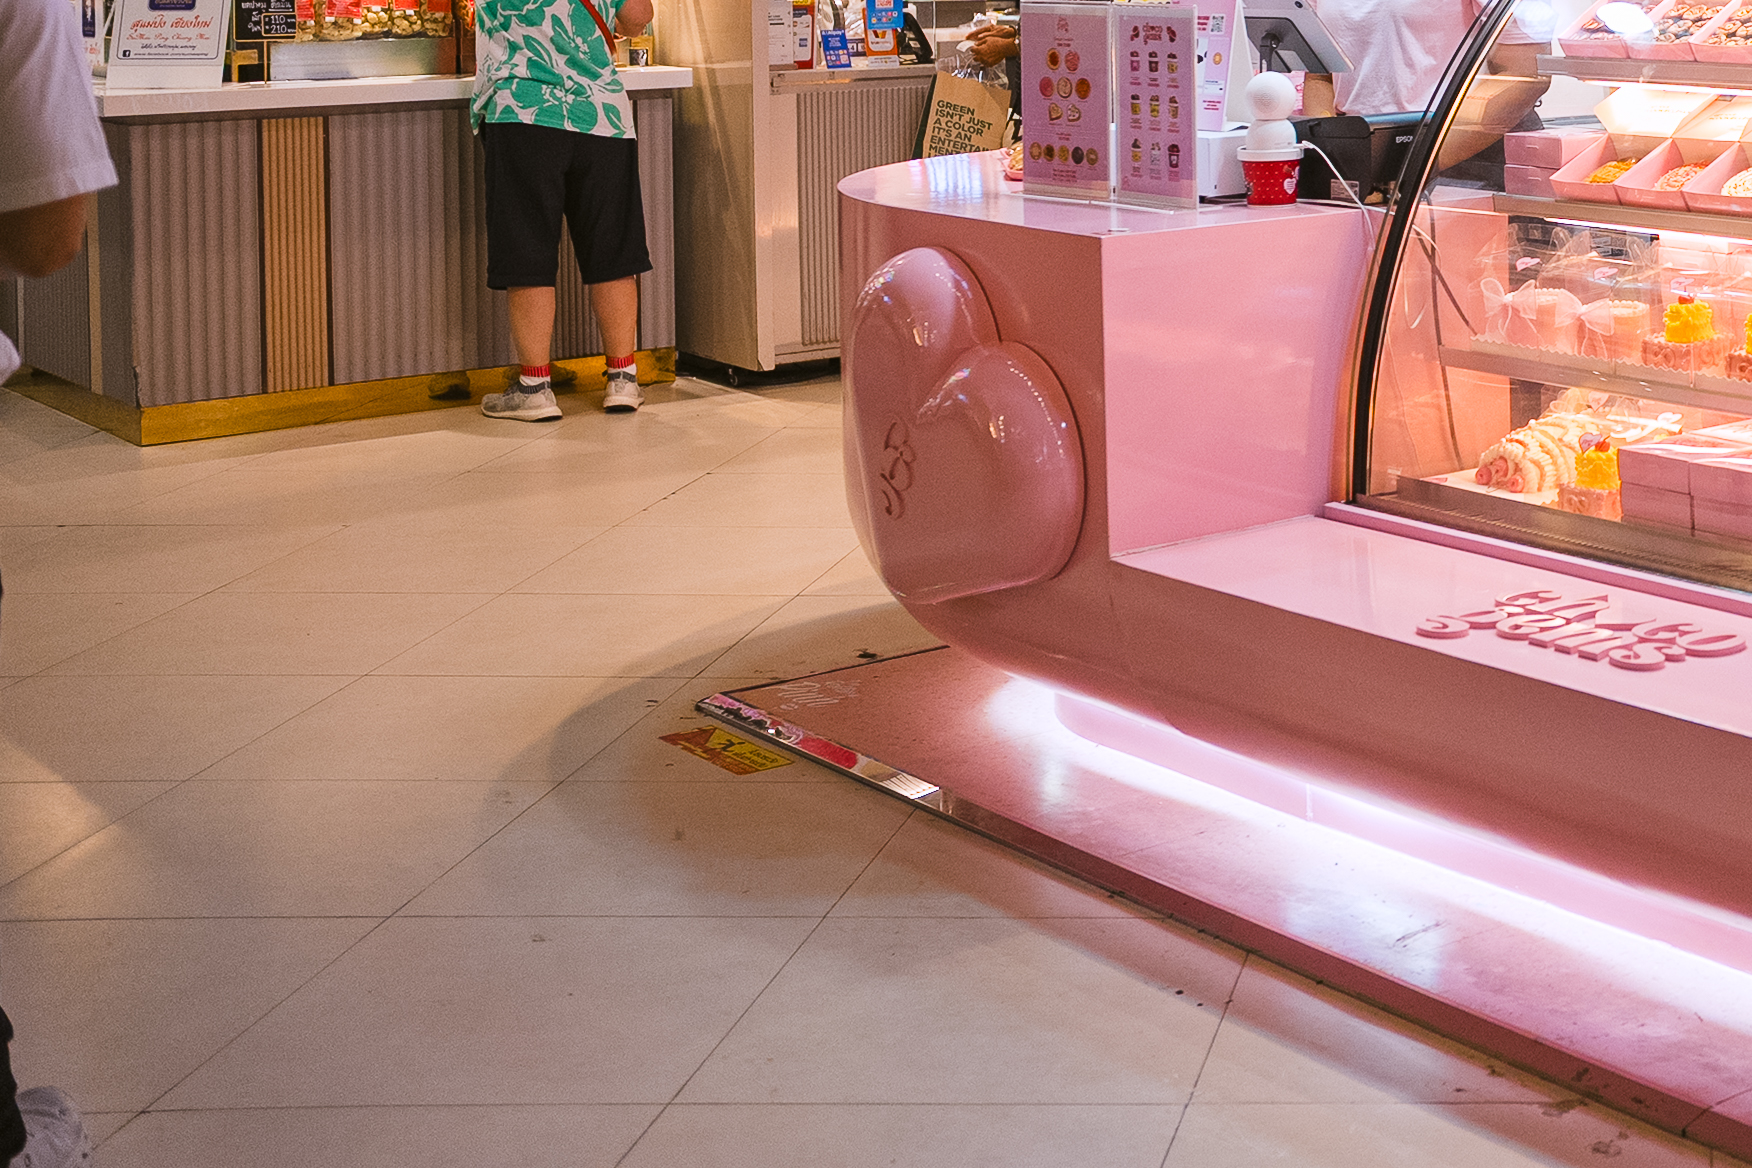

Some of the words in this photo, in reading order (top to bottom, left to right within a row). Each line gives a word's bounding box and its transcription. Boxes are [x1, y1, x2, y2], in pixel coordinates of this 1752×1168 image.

[270, 15, 286, 23] 110
[270, 24, 287, 34] 210
[936, 99, 975, 116] GREEN
[933, 118, 942, 126] A
[945, 119, 984, 137] COLOR
[935, 108, 964, 122] ISN'T
[965, 116, 993, 130] JUST
[931, 125, 952, 138] IT'S
[954, 131, 972, 142] AN
